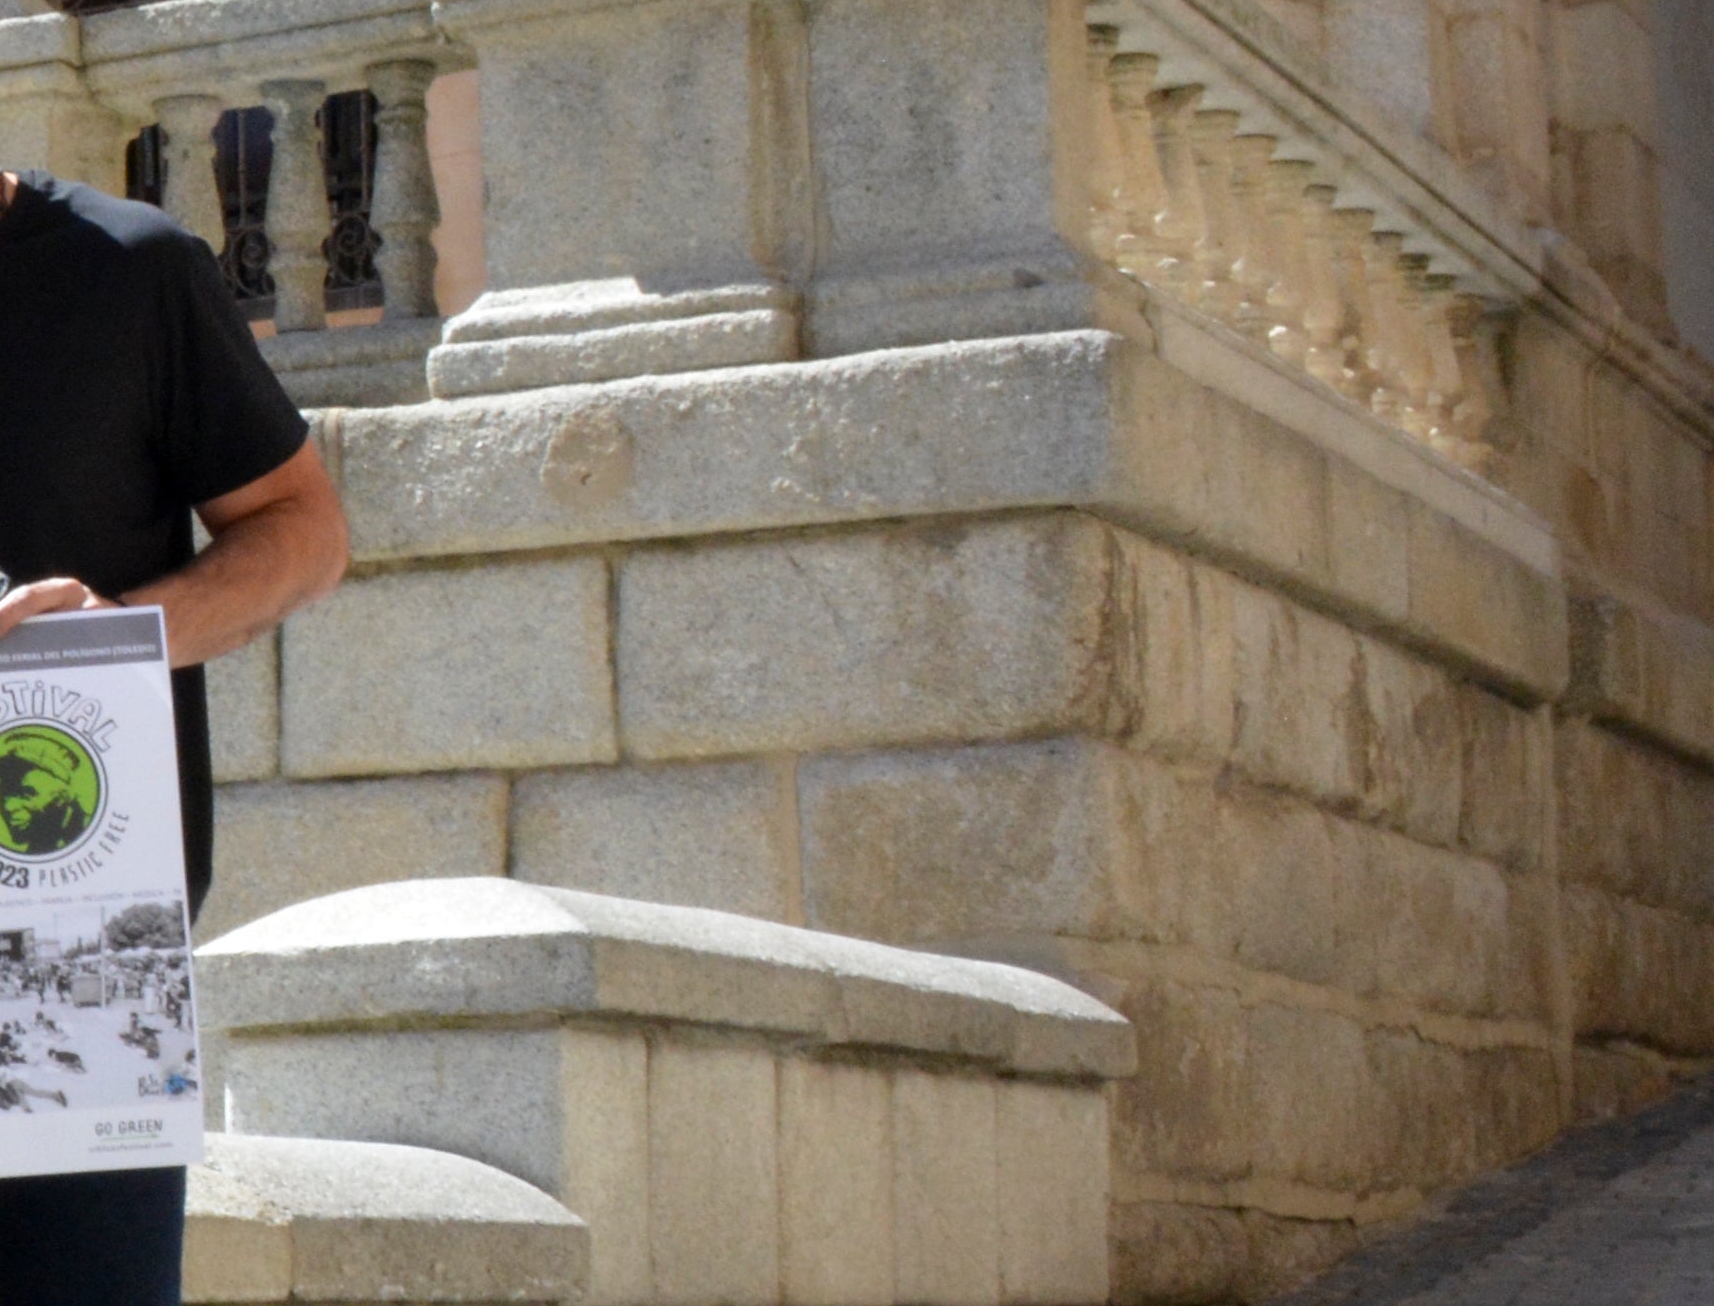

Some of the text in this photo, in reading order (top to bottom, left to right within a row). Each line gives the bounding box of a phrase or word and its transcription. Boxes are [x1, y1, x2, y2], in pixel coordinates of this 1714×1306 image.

[38, 851, 104, 888] PLASTIC
[98, 810, 130, 855] FREE
[94, 1118, 163, 1137] GO GREEN
